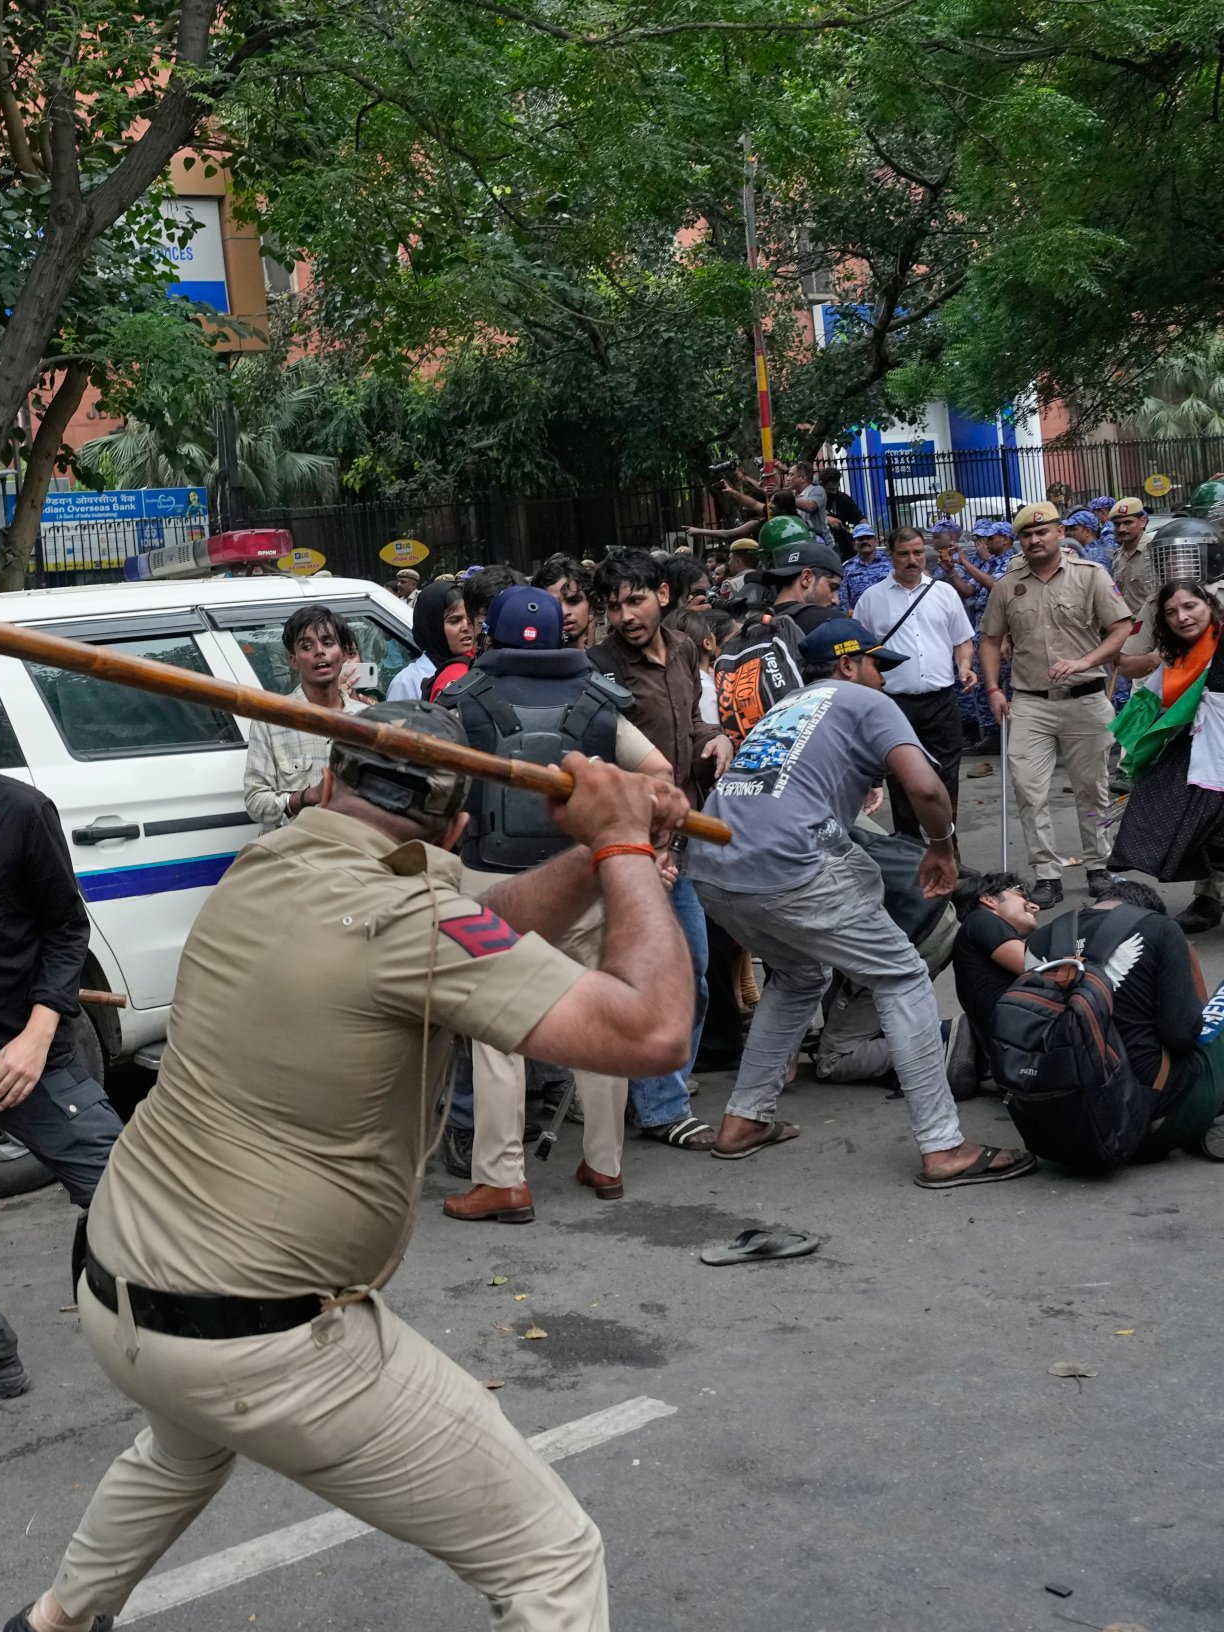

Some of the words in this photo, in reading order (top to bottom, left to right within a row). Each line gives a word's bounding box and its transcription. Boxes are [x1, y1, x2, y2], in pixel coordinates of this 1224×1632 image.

[43, 505, 65, 514] dian
[67, 504, 111, 513] Overseas
[112, 502, 136, 511] Bank
[761, 651, 786, 688] safari
[786, 701, 833, 766] INTERNATIONAL
[725, 781, 764, 796] SPRINGS
[771, 774, 790, 799] CREW
